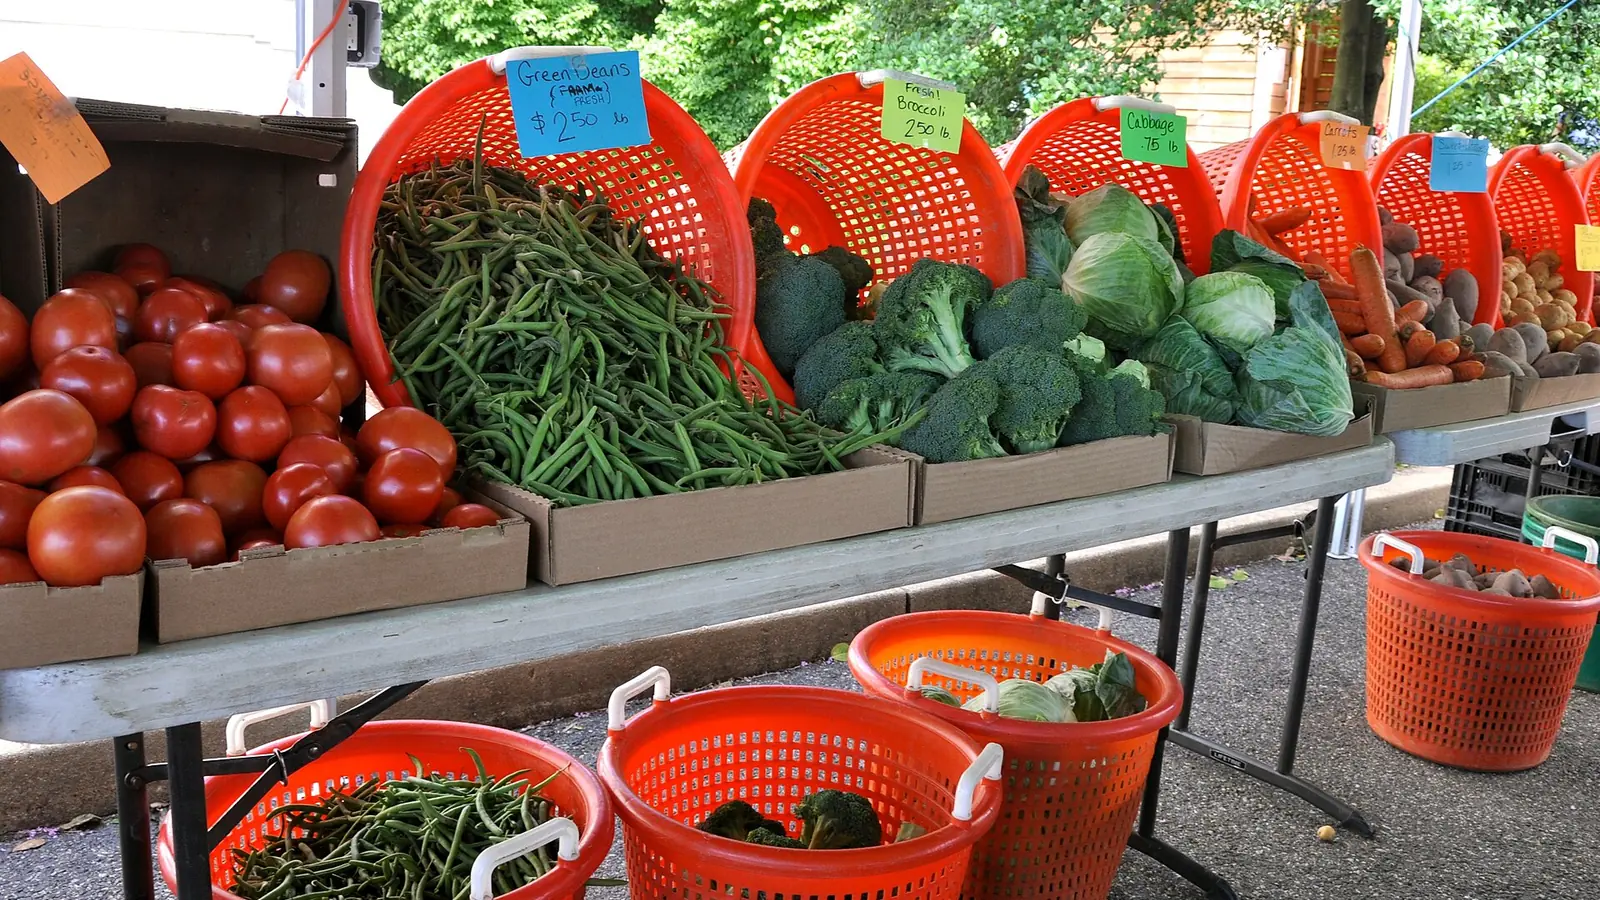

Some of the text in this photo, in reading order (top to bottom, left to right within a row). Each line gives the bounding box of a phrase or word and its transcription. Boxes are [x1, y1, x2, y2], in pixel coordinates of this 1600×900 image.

[517, 55, 631, 86] Green Beans
[905, 82, 941, 101] Fresh!
[897, 95, 946, 117] Broccoli
[1127, 111, 1175, 136] Cabbage
[1324, 122, 1357, 139] Carrots
